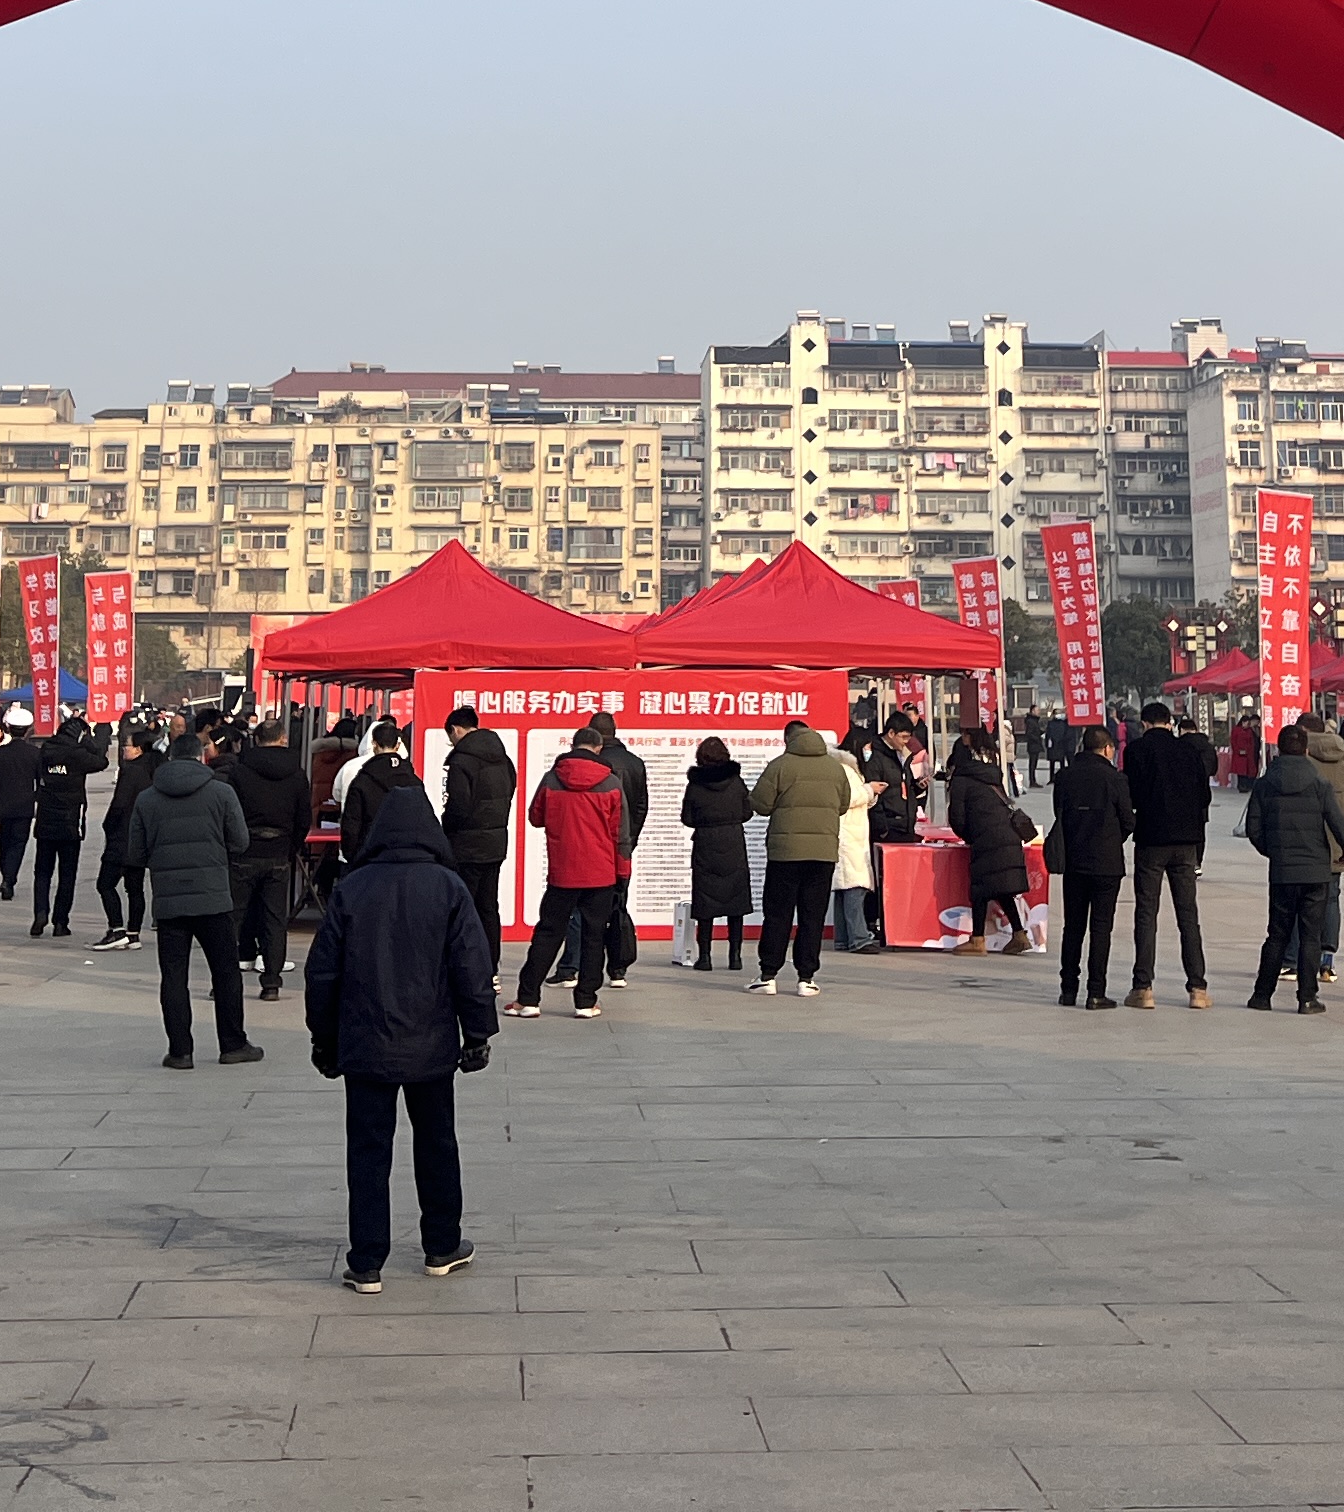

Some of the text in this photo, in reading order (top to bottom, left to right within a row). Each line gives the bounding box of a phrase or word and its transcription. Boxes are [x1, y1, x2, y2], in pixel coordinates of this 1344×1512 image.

[453, 690, 809, 716] 暖心服务办实事 凝心聚力促就业
